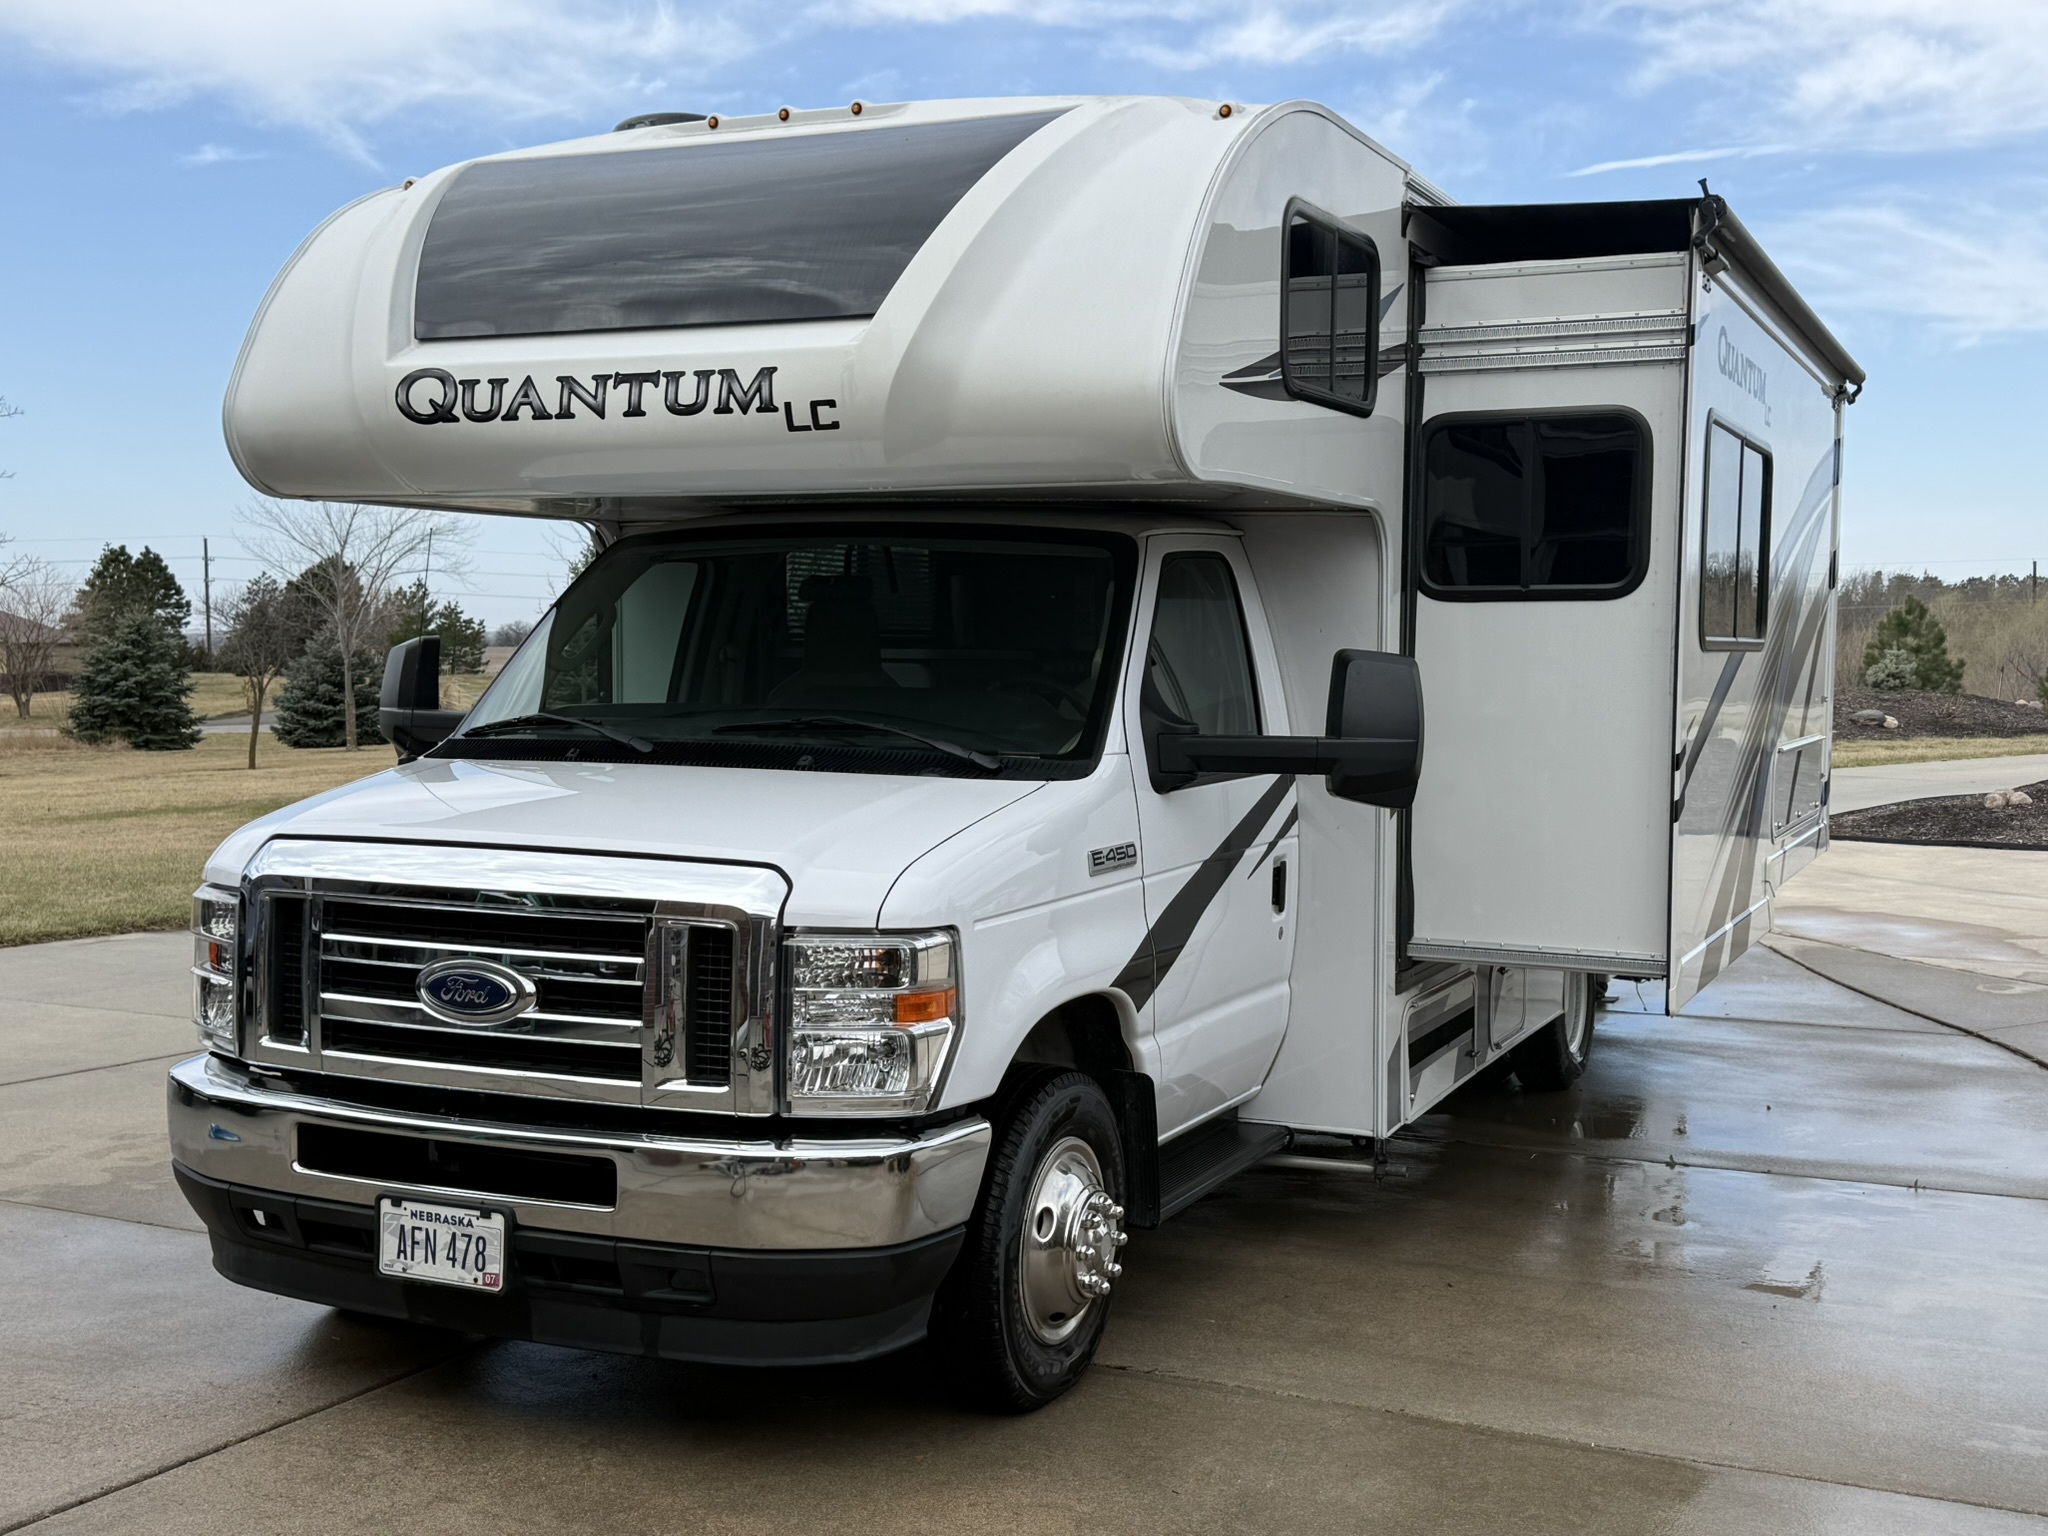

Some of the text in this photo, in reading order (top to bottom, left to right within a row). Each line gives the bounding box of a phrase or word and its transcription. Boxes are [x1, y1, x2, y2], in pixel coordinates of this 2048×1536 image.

[1718, 325, 1767, 405] QUANTUM
[395, 366, 840, 432] QUANTUM LC
[440, 975, 491, 1004] Ford
[410, 1209, 474, 1229] NEBRASKA
[396, 1224, 487, 1273] AFN 478
[485, 1274, 496, 1284] 07
